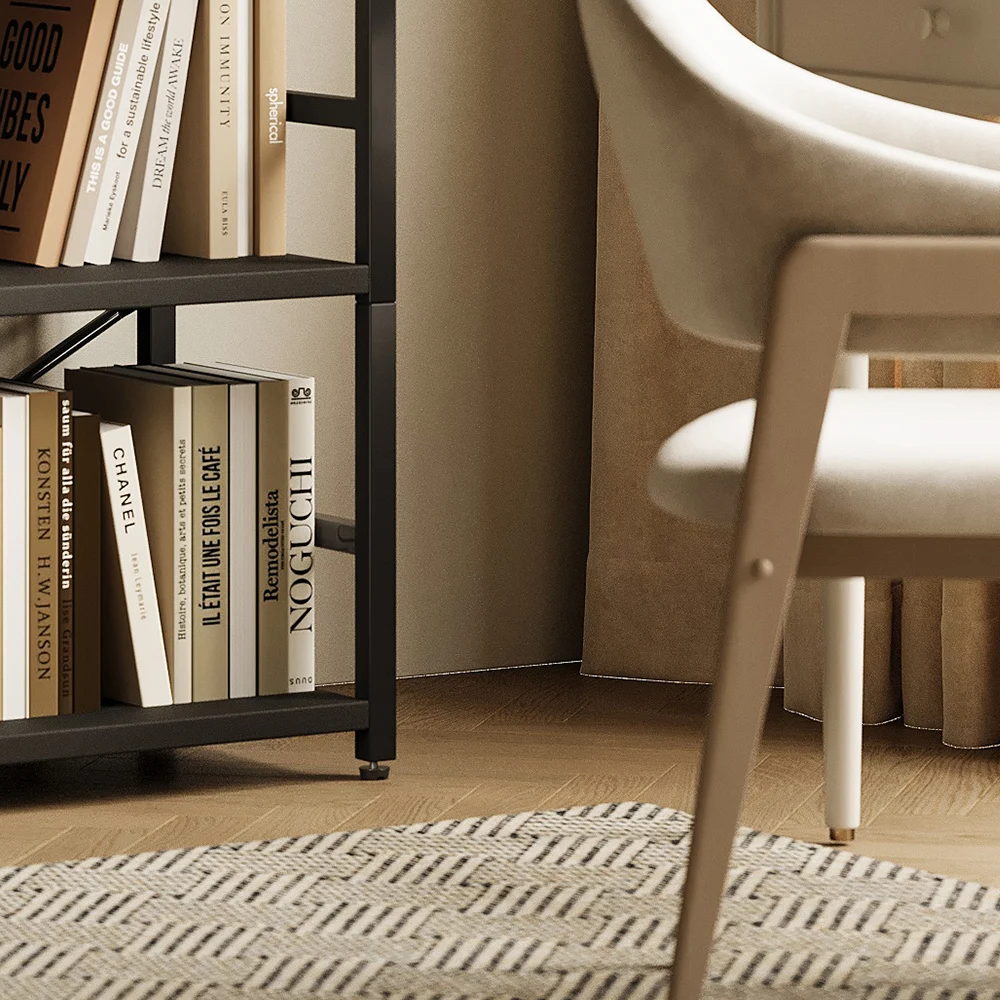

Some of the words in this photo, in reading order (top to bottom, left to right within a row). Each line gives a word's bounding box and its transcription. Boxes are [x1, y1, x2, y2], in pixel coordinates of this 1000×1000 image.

[141, 2, 162, 52] lifestyle
[220, 4, 231, 26] ON
[0, 18, 63, 74] GOOD
[112, 42, 129, 87] GUIDE
[168, 38, 184, 90] AWAKE
[126, 54, 149, 127] sustainable
[220, 36, 231, 128] IMMUNITY
[101, 88, 118, 132] GOOD
[165, 88, 176, 118] world
[268, 87, 284, 145] spherical
[98, 134, 108, 146] A
[123, 130, 132, 138] a
[162, 119, 172, 134] the
[96, 146, 105, 160] IS
[116, 141, 129, 159] for
[152, 136, 170, 188] DREAM
[86, 162, 102, 194] THIS
[62, 399, 70, 437] saum
[62, 441, 74, 464] für
[198, 446, 221, 482] CAFÉ
[37, 448, 51, 540] KONSTEN
[62, 467, 74, 494] alla
[112, 447, 136, 535] CHANEL
[178, 478, 187, 506] petits
[202, 484, 221, 502] LE
[62, 498, 74, 520] die
[178, 510, 186, 518] et
[202, 505, 221, 536] FOIS
[62, 524, 74, 590] sünderin
[202, 538, 221, 568] UNE
[262, 489, 280, 602] Remodelista
[288, 457, 314, 634] NOGUCHI
[178, 544, 188, 595] botanique,
[198, 572, 221, 610] ÉTAIT
[178, 598, 187, 640] Histoire,
[202, 612, 221, 626] IL
